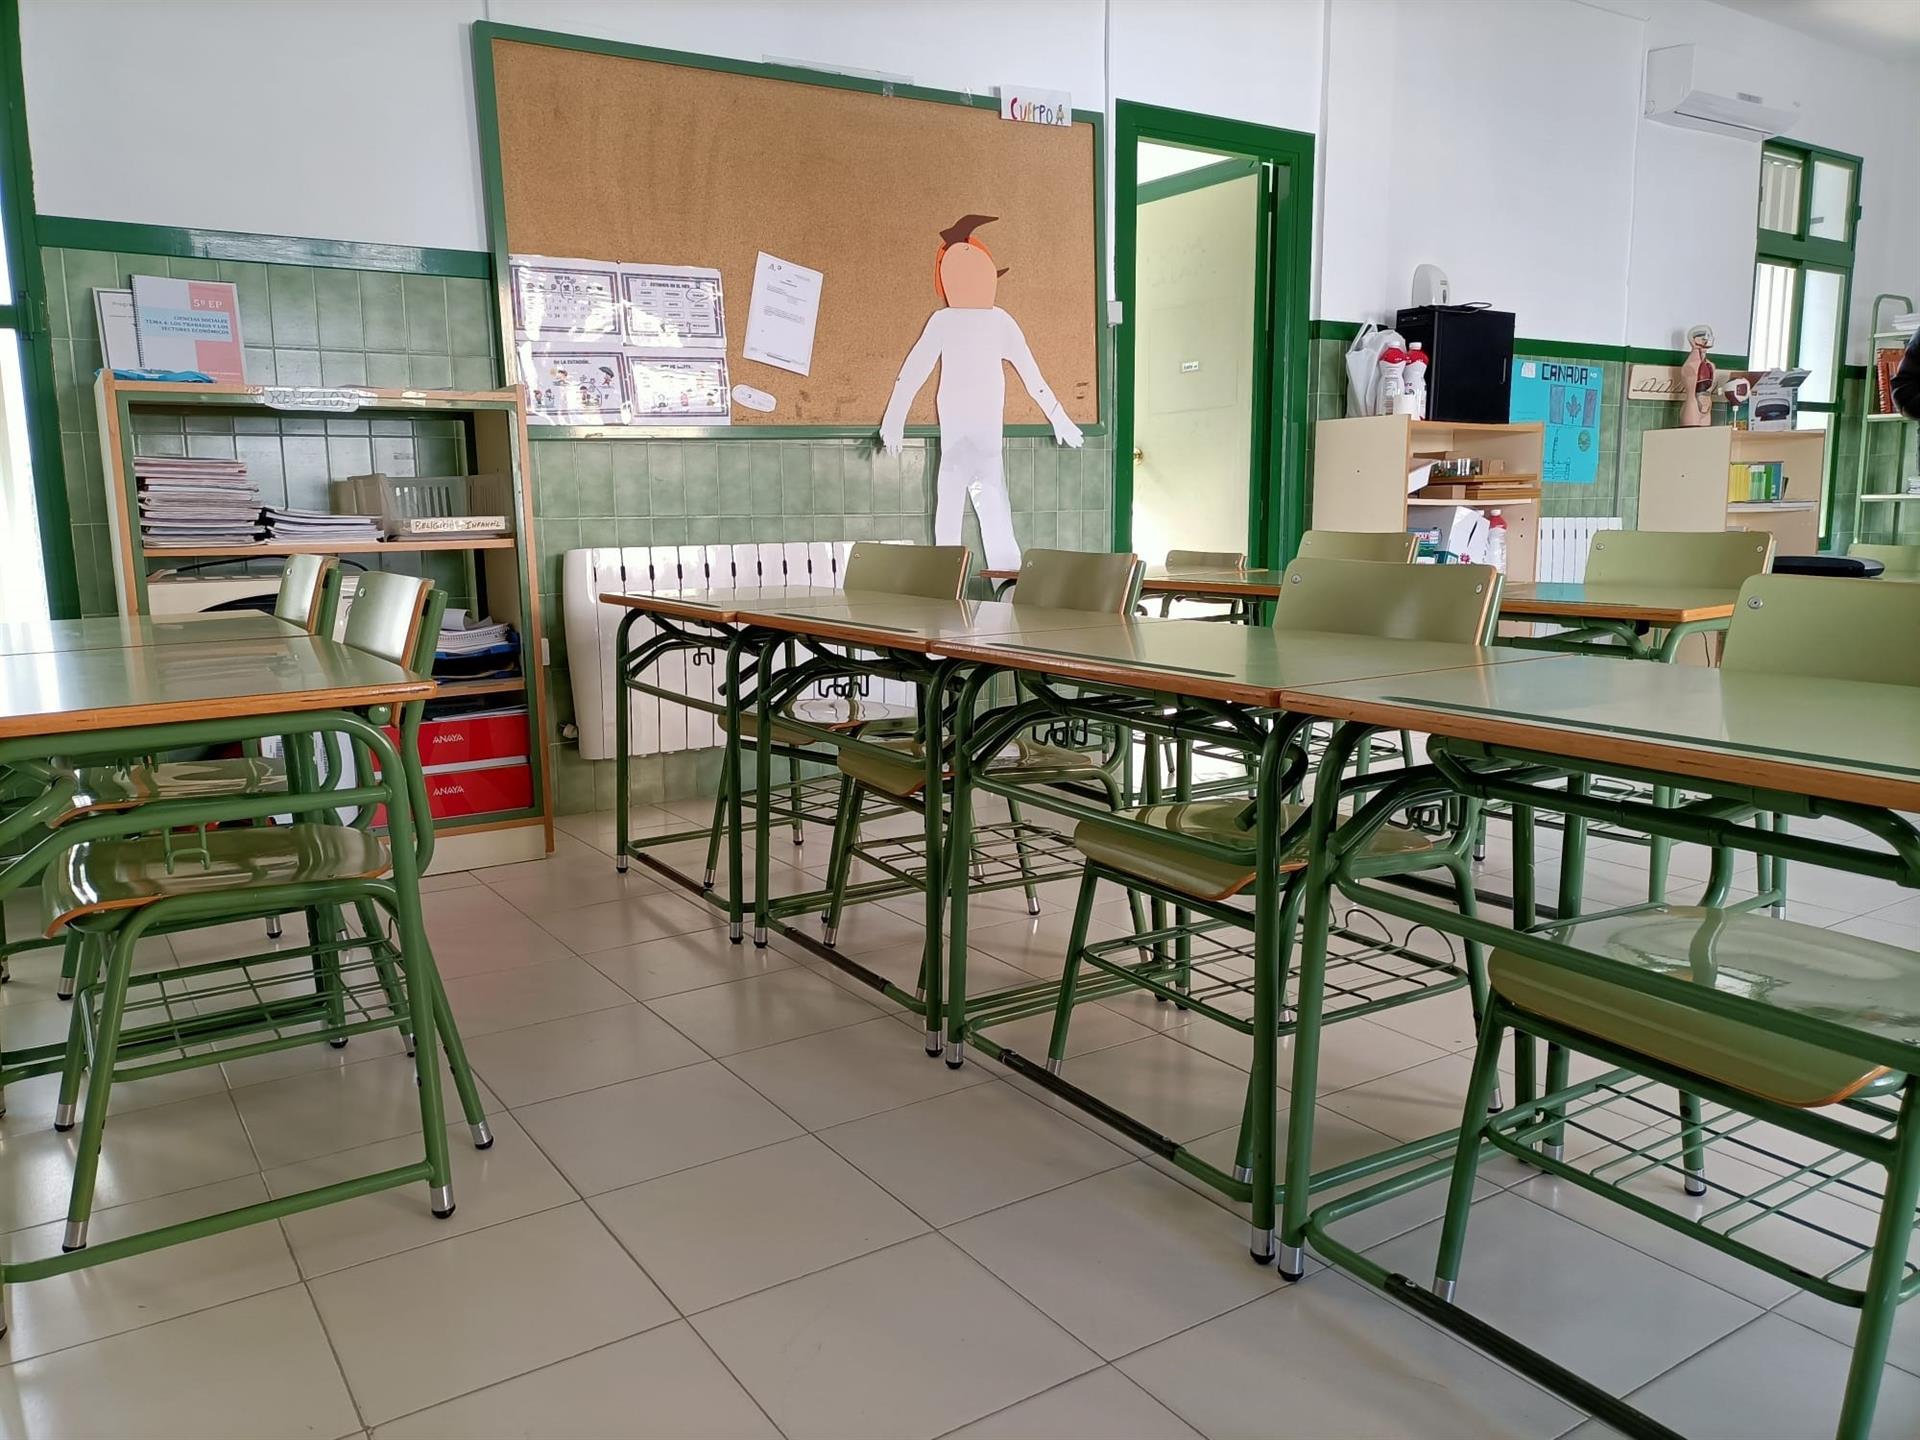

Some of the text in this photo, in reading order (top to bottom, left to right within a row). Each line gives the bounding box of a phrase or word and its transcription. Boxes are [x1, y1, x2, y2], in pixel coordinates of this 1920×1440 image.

[208, 300, 223, 309] EP
[1541, 362, 1589, 386] CANADA
[432, 733, 465, 744] ANAYA
[433, 785, 465, 796] ANAYA
